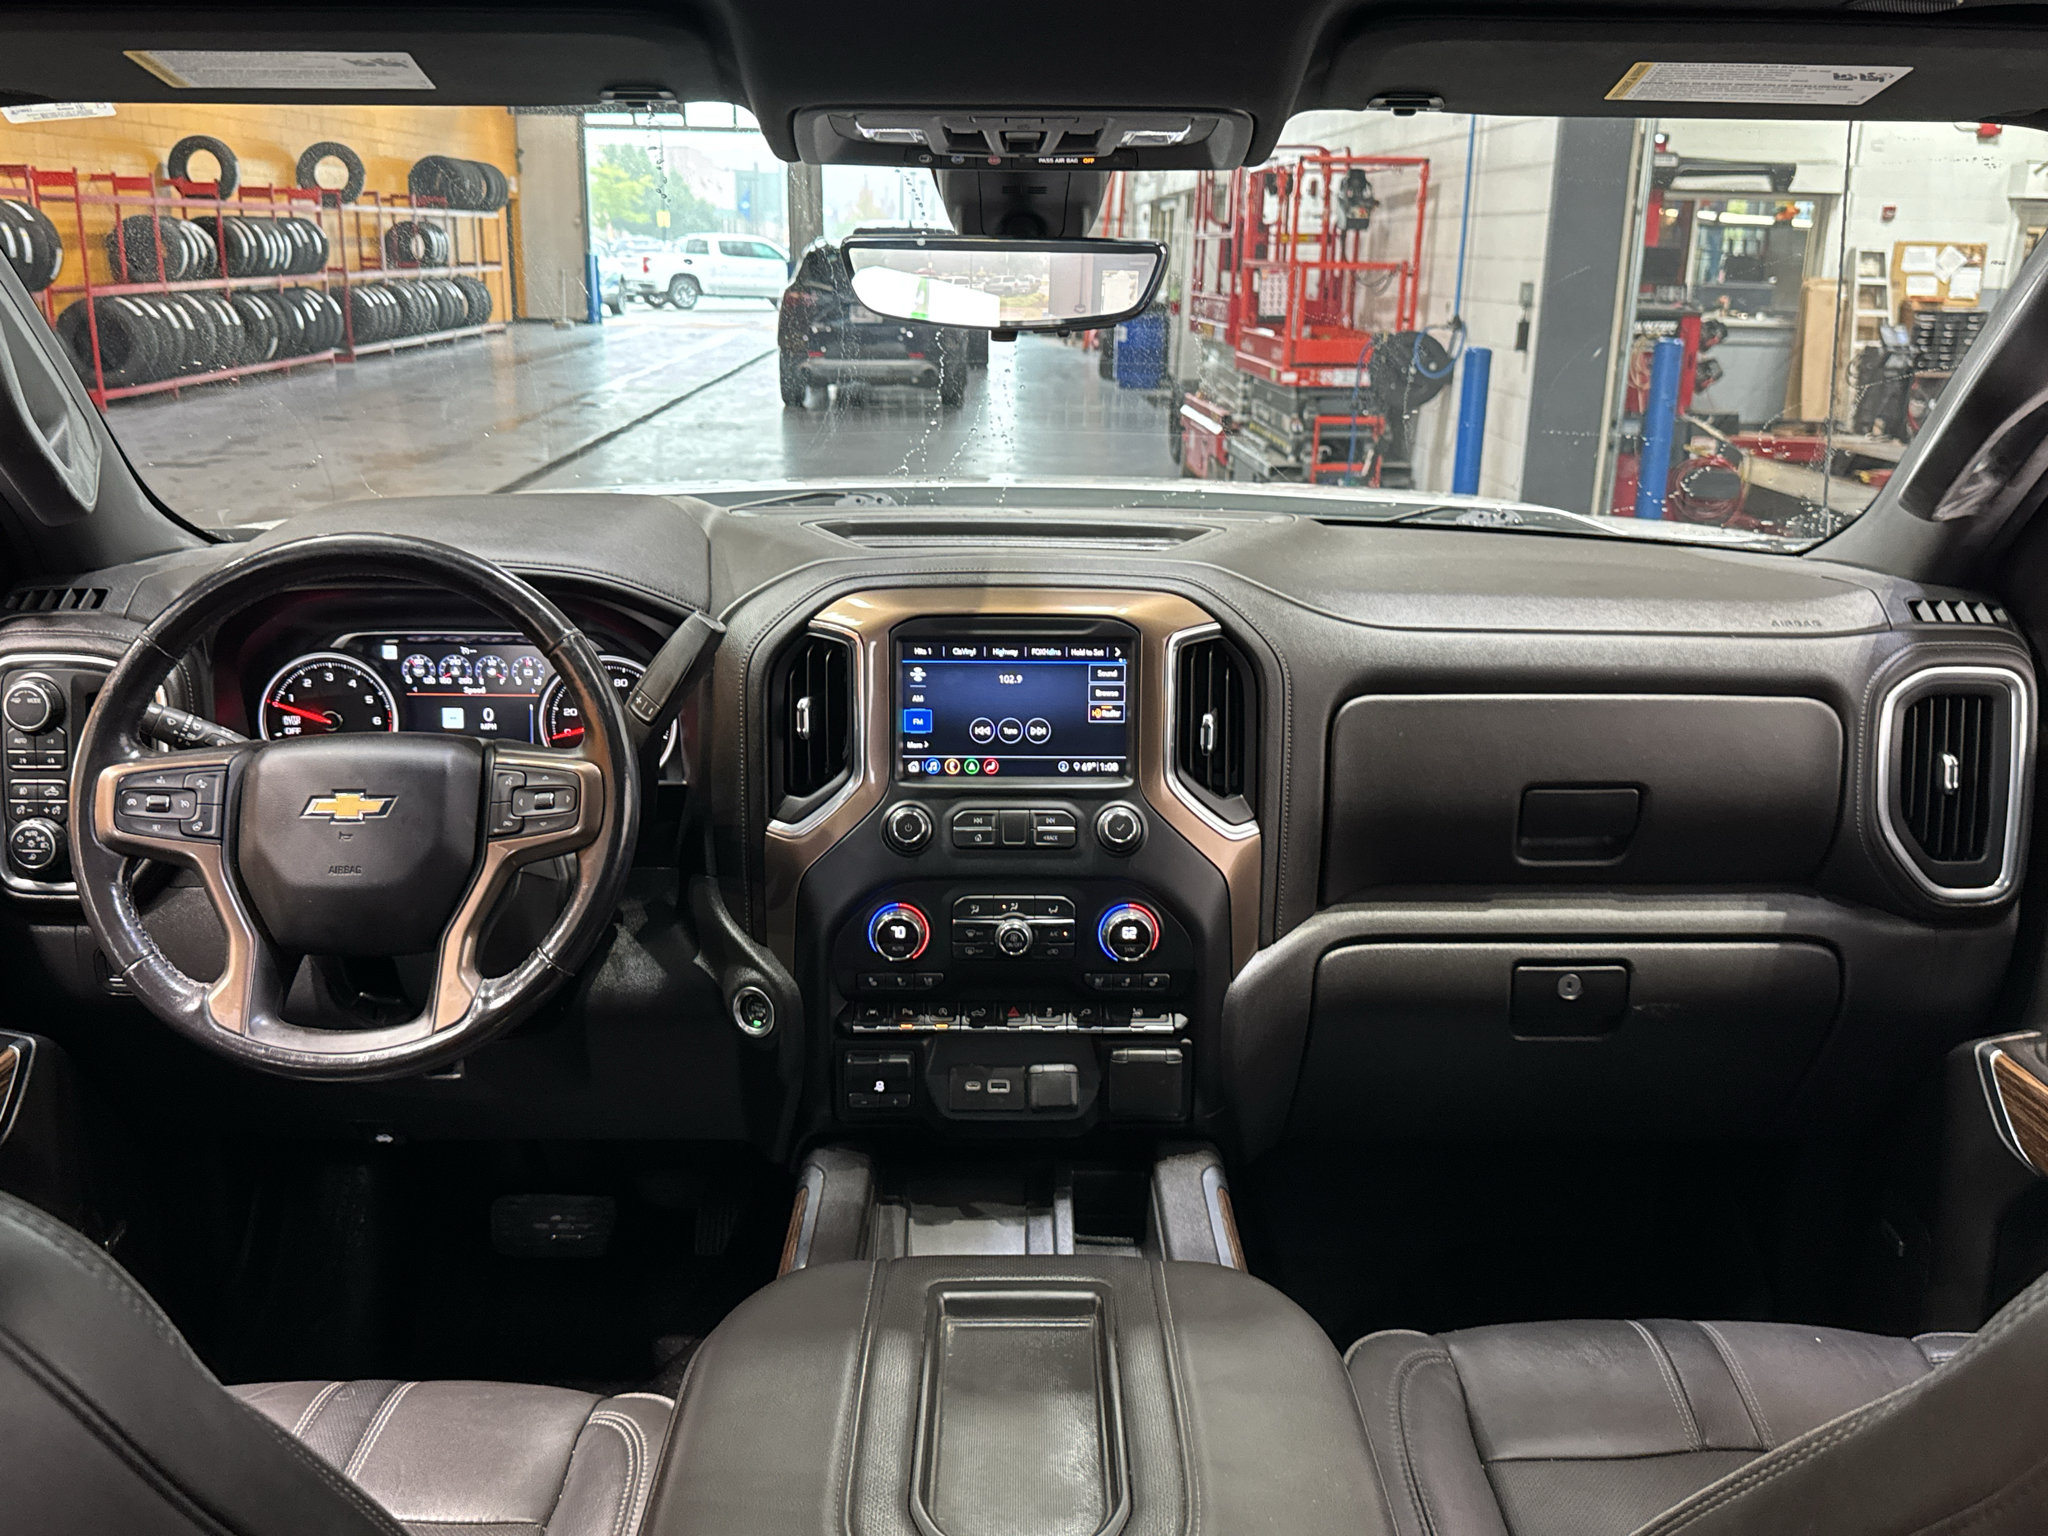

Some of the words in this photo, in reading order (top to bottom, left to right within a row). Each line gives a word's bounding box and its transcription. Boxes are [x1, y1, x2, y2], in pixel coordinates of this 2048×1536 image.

[325, 672, 334, 682] 3
[1097, 669, 1118, 678] Sound
[302, 679, 312, 688] 2
[348, 679, 357, 688] 4
[614, 678, 628, 687] 80
[999, 674, 1023, 684] 102.9
[463, 686, 487, 695] Speed
[1095, 689, 1119, 697] Browse
[288, 694, 294, 702] 1
[364, 695, 374, 704] 5
[912, 694, 925, 702] AM
[483, 708, 494, 722] 0
[563, 708, 578, 717] 20
[372, 716, 382, 725] 6
[912, 717, 924, 725] FM
[284, 727, 301, 735] OFF
[1003, 727, 1018, 735] Tune
[906, 741, 923, 749] More
[328, 865, 362, 875] AIRBAG
